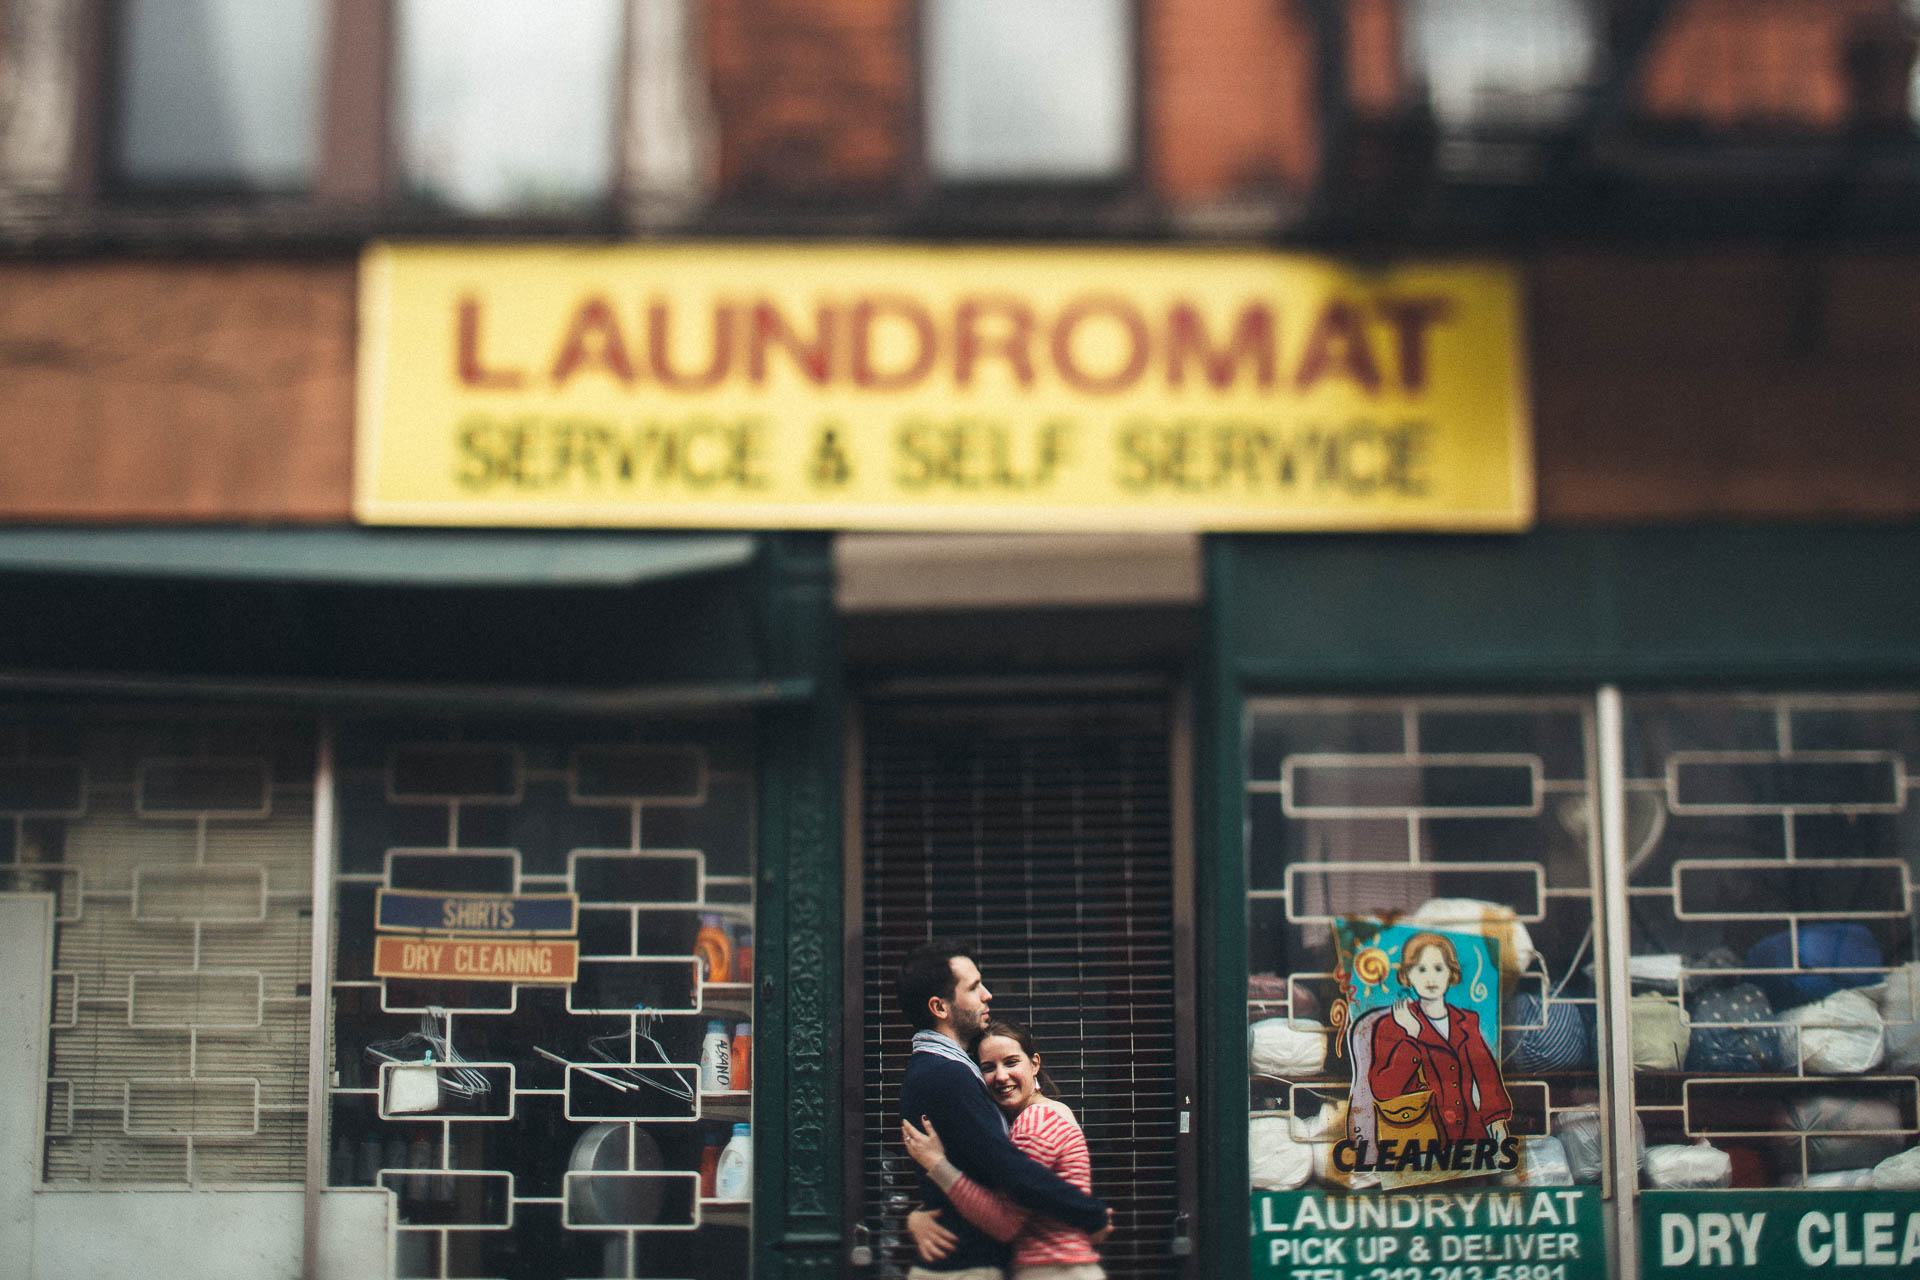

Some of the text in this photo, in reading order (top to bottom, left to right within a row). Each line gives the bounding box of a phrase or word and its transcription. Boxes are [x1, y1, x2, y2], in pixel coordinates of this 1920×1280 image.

[454, 290, 1453, 399] LAUNDROMAT
[454, 414, 1434, 497] SERVICE & SELF SERVICE
[441, 899, 515, 929] SHIRTS
[402, 943, 553, 974] DRY CLEANING
[1332, 1137, 1520, 1172] CLEANERS
[1261, 1190, 1584, 1233] LAUNDRYMAT
[1270, 1232, 1580, 1266] PICK UP & DELIVER
[1660, 1212, 1767, 1267] DRY
